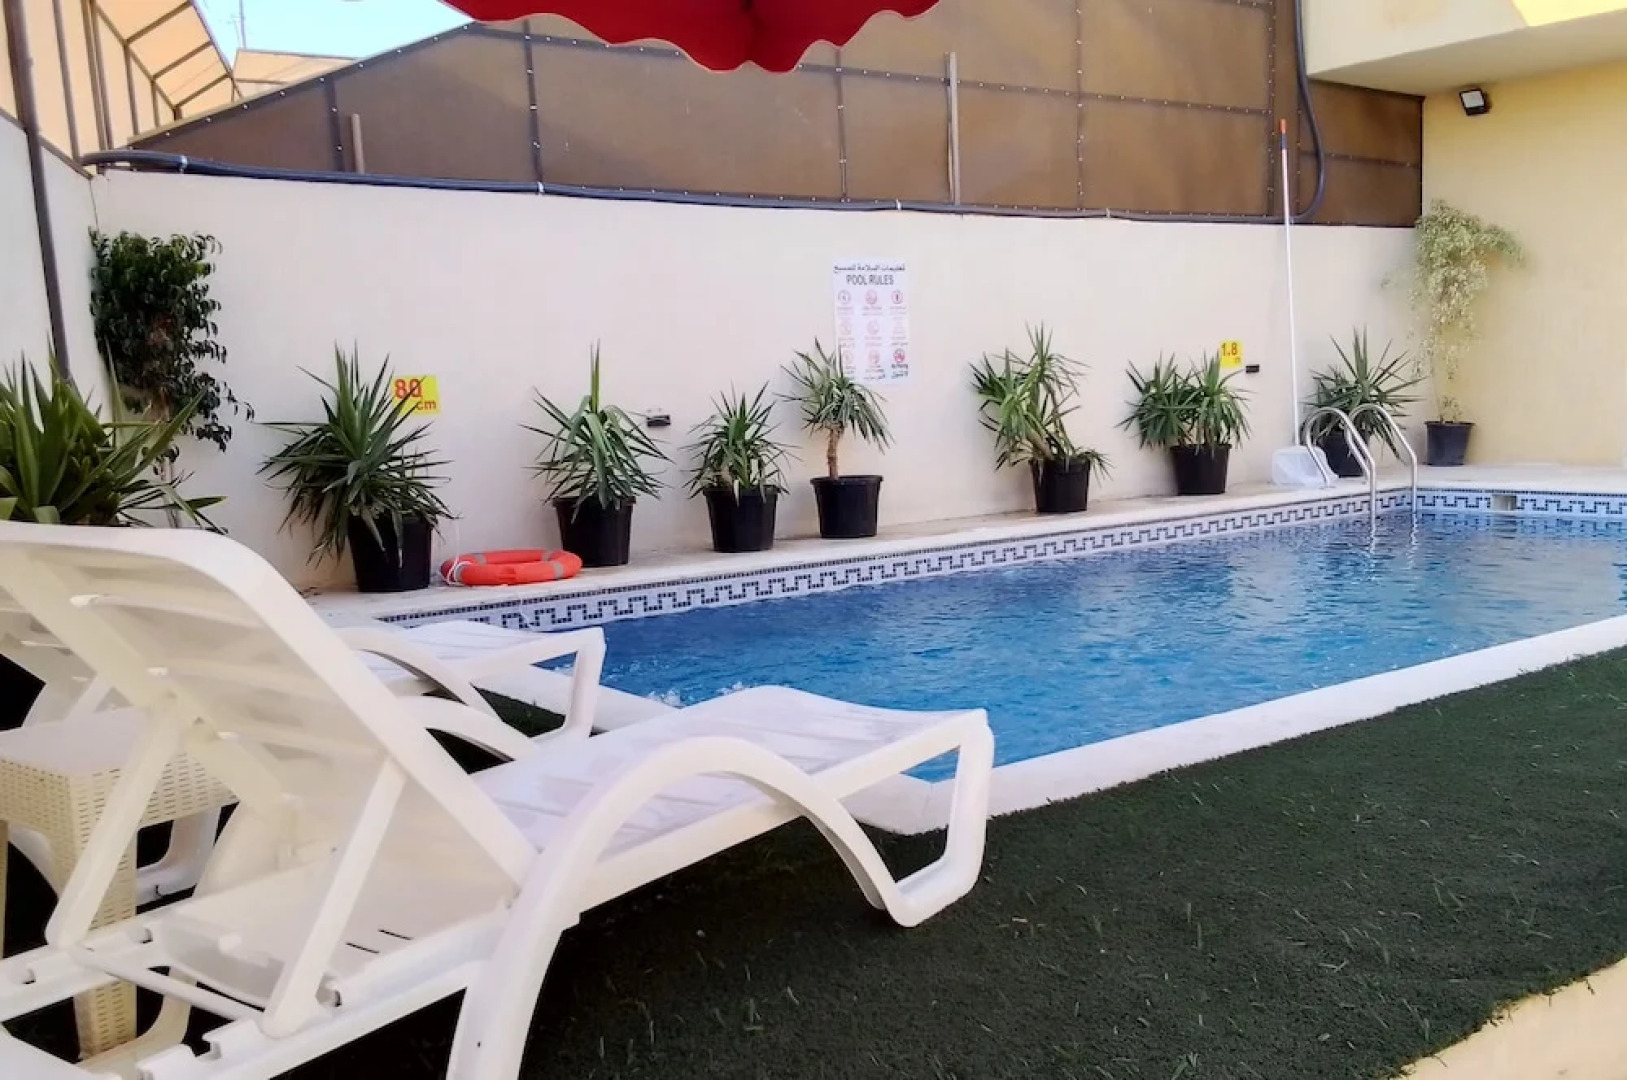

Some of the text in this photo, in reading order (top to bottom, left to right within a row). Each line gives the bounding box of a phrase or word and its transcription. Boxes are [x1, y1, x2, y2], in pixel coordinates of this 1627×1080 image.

[846, 274, 894, 286] POOL RULES
[1221, 341, 1238, 356] 1.8
[395, 378, 422, 399] 80
[416, 401, 437, 411] cm
